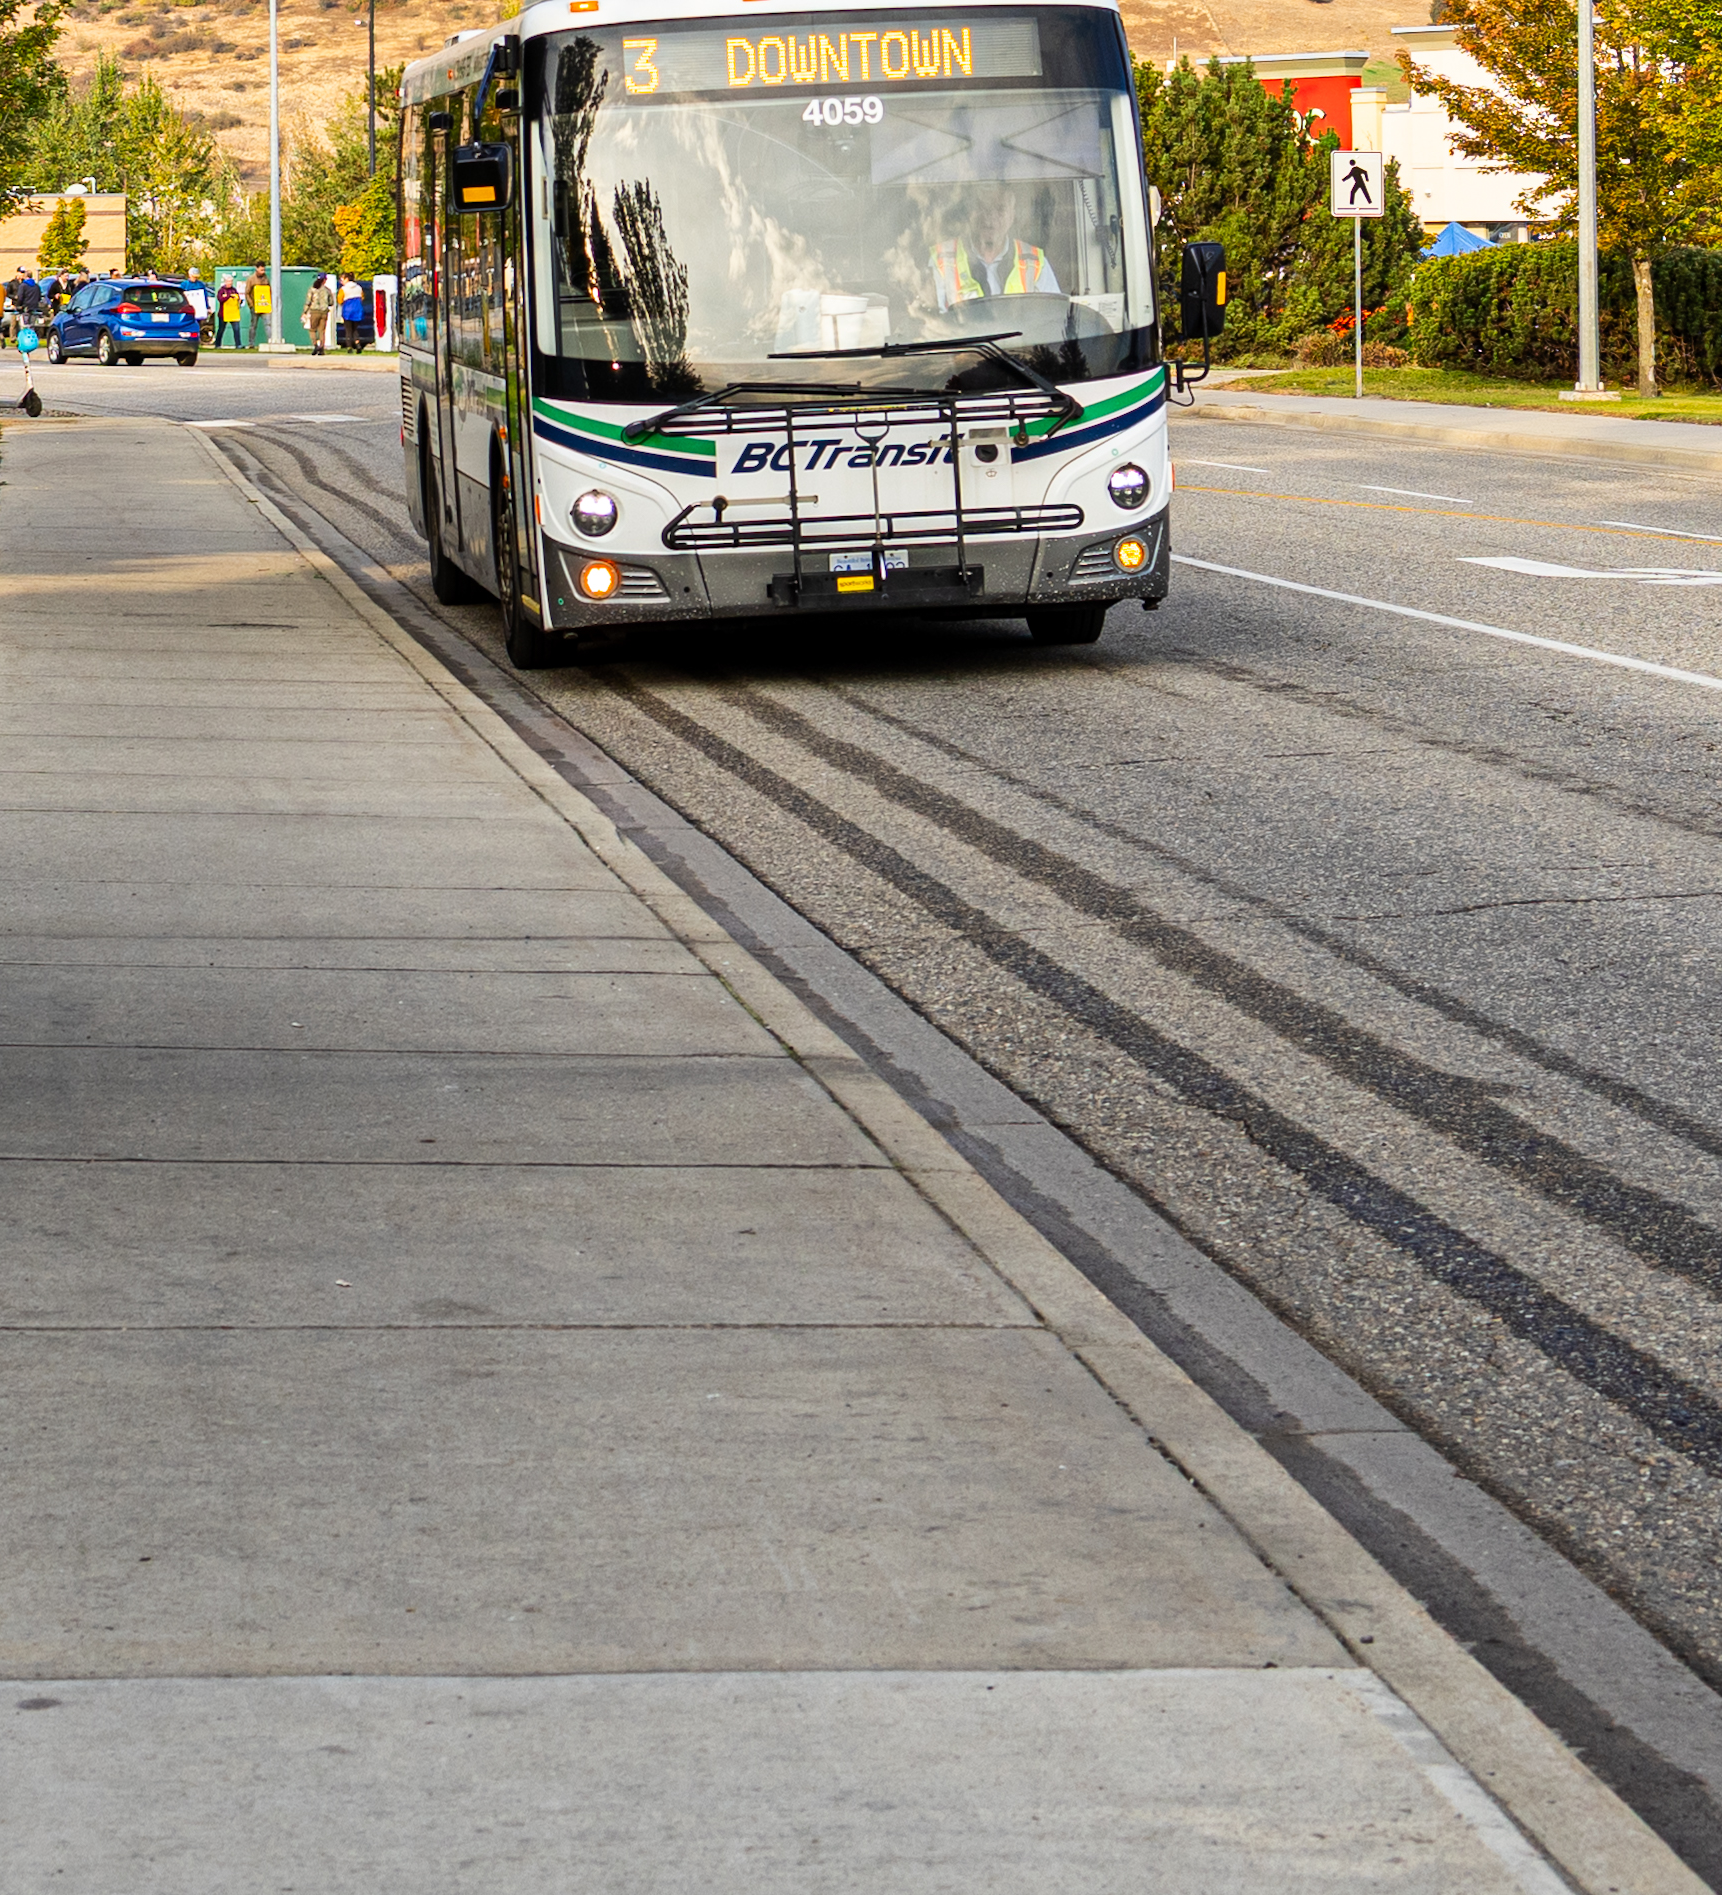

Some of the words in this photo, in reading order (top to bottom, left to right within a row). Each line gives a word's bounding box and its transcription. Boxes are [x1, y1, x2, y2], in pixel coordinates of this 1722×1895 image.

[622, 37, 660, 94] 3
[726, 27, 973, 87] DOWNTOWN
[802, 96, 884, 127] 4059
